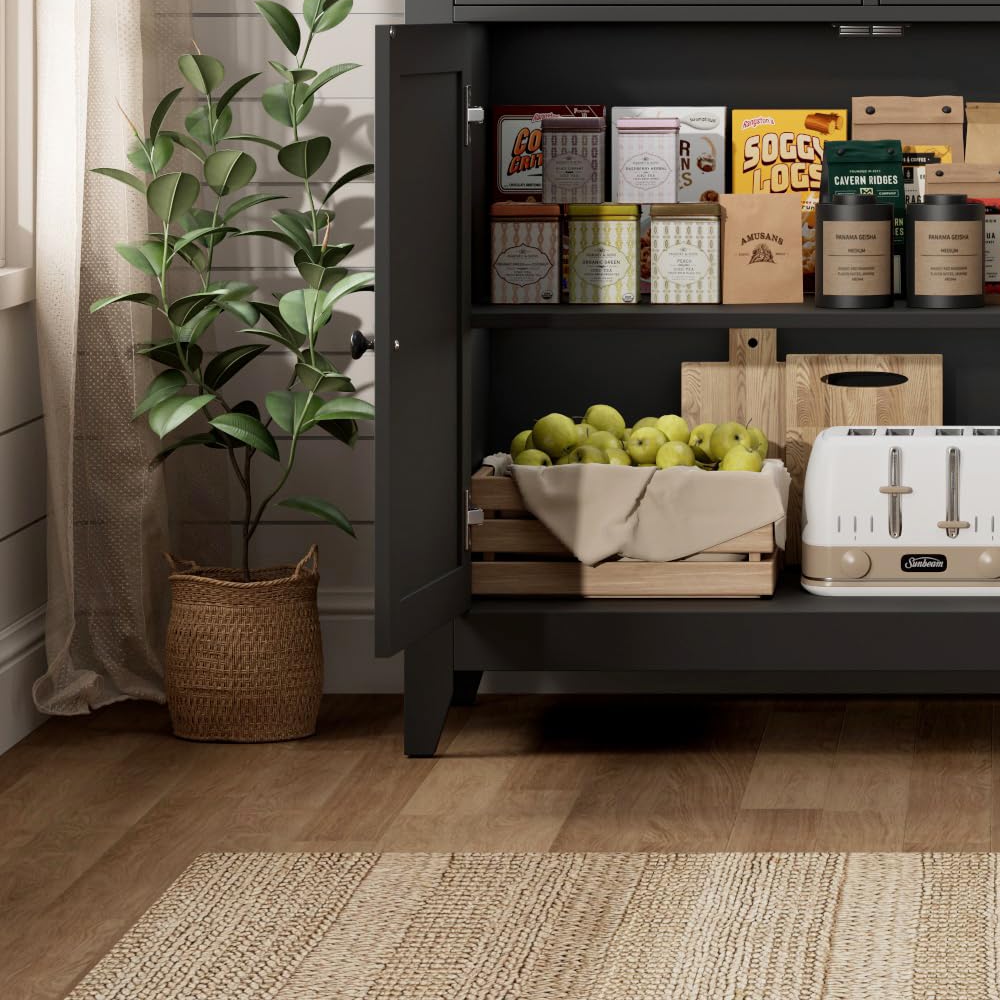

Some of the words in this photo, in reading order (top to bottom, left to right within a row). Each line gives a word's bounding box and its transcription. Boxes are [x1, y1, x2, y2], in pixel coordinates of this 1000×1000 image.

[743, 132, 824, 174] SOGGY
[752, 162, 822, 194] LOGS
[834, 175, 867, 186] CAVERN
[868, 175, 898, 185] RIDGES
[741, 232, 784, 245] AMUSANS
[904, 557, 944, 569] Sunbeam
